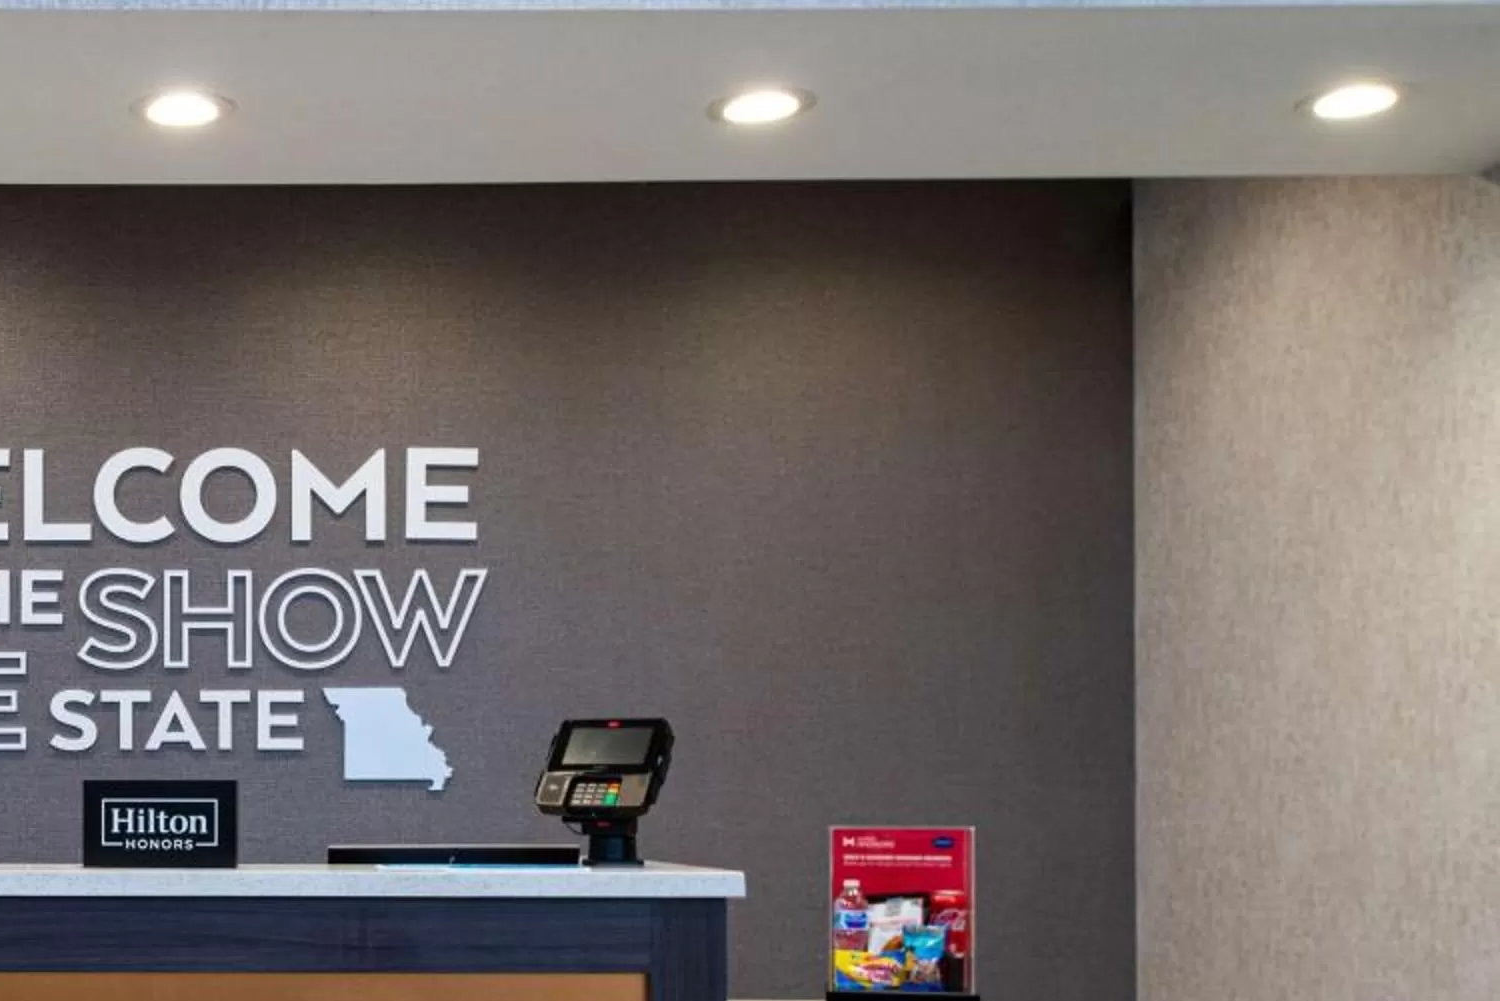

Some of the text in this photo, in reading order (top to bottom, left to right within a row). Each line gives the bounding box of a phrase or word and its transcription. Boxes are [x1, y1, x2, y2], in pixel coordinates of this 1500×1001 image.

[77, 567, 488, 670] SHOW
[49, 689, 304, 750] STATE
[110, 807, 208, 834] Hilton
[124, 839, 194, 851] HONORS
